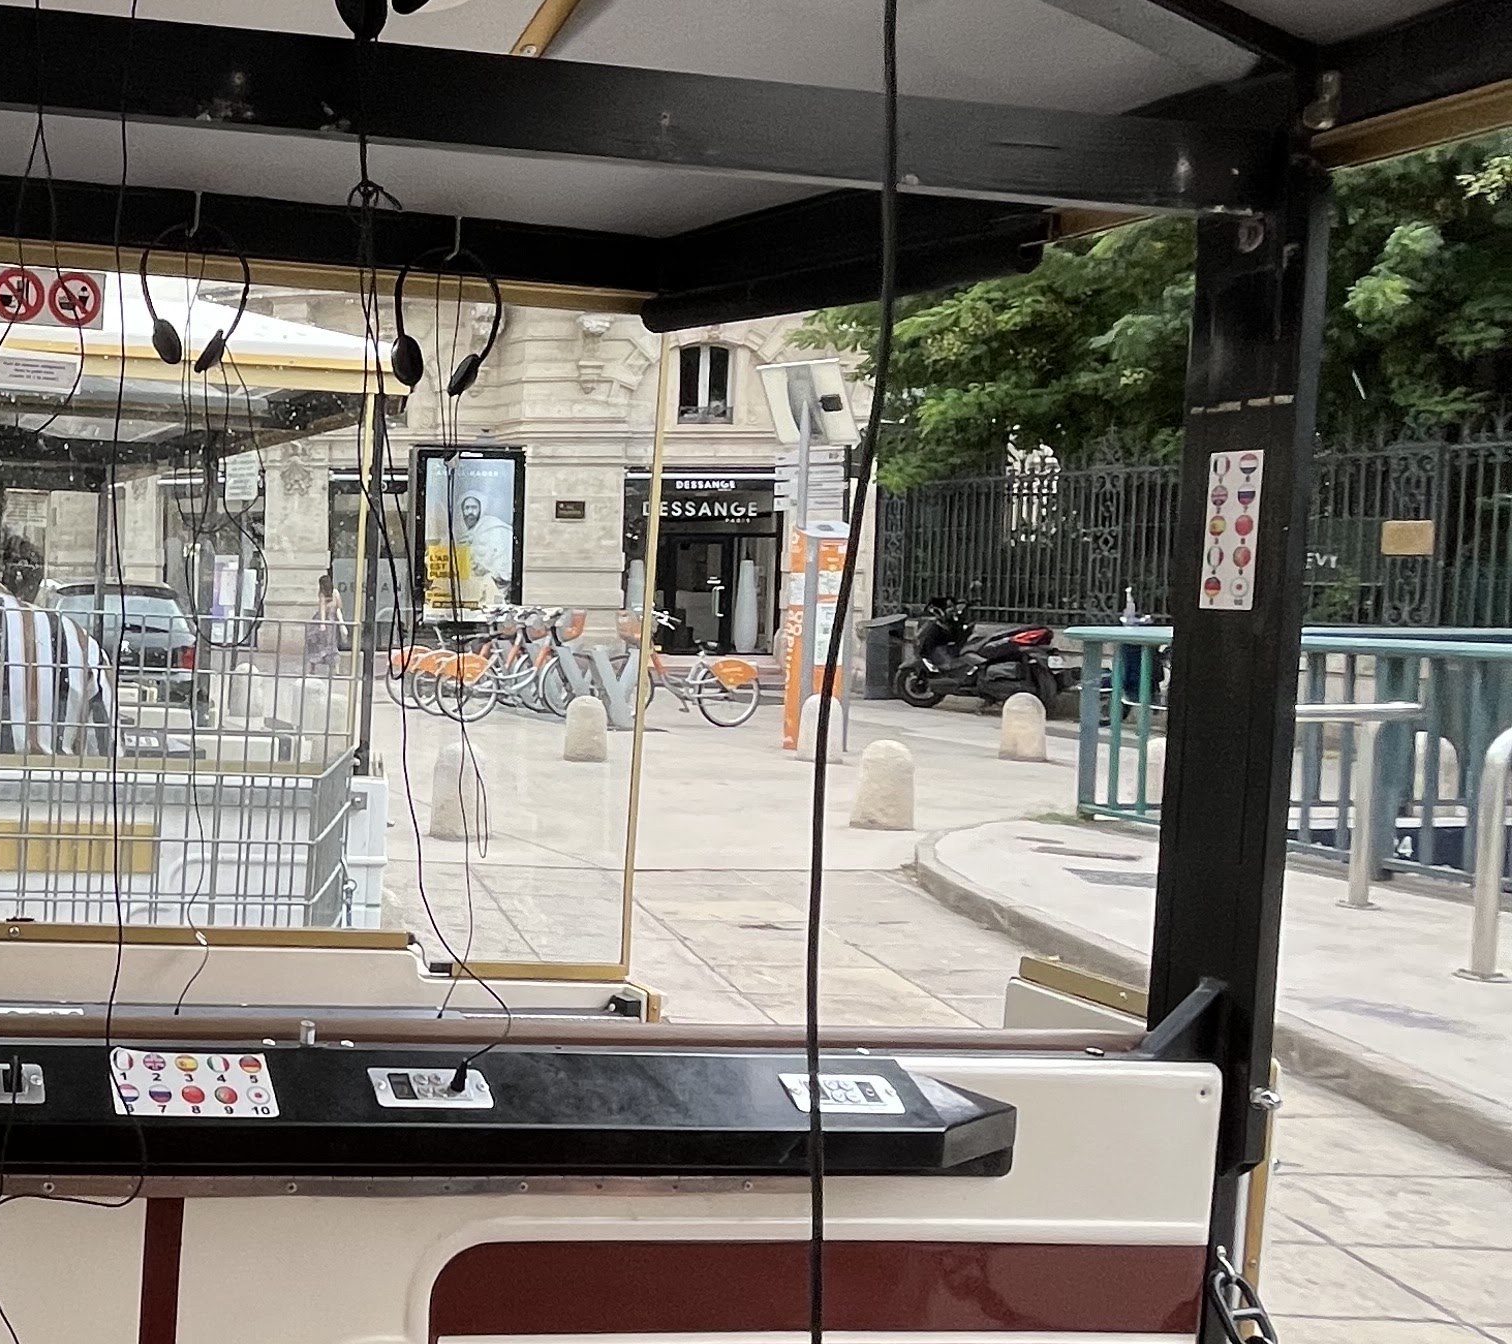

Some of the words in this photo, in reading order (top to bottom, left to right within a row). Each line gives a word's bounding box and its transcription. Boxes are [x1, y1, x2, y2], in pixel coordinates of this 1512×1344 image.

[675, 480, 736, 490] DESSANGE
[642, 501, 758, 517] DESSANGE
[119, 1072, 128, 1081] 1
[152, 1073, 162, 1082] 2
[184, 1073, 194, 1083] 3
[216, 1074, 227, 1083] 4
[249, 1074, 259, 1084] 5
[159, 1104, 168, 1113] 7
[192, 1105, 202, 1114] 8
[224, 1105, 234, 1115] 9
[251, 1106, 271, 1115] 10
